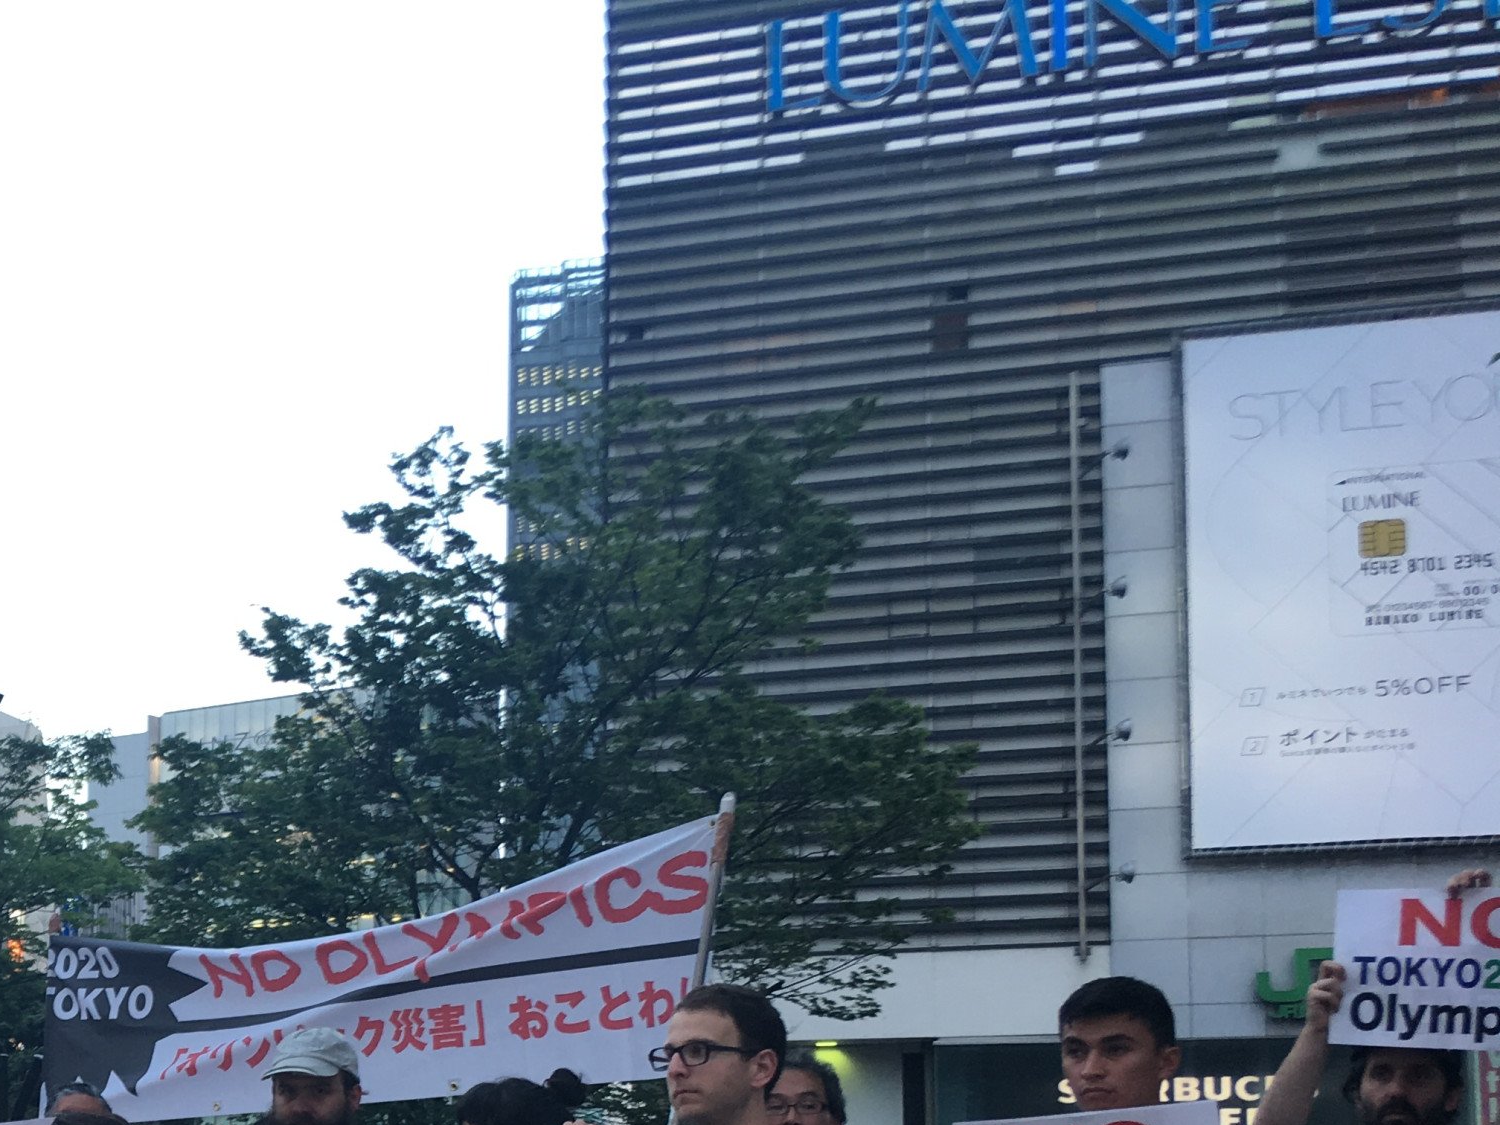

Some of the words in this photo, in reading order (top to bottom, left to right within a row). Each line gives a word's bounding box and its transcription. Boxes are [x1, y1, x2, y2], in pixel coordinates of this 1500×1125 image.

[1342, 490, 1422, 513] LUMINE
[1374, 674, 1472, 698] 5%OFF
[1279, 727, 1358, 747] ポイント
[199, 948, 301, 999] NO
[315, 848, 711, 985] OLYMPICS
[508, 976, 689, 1041] おことわ
